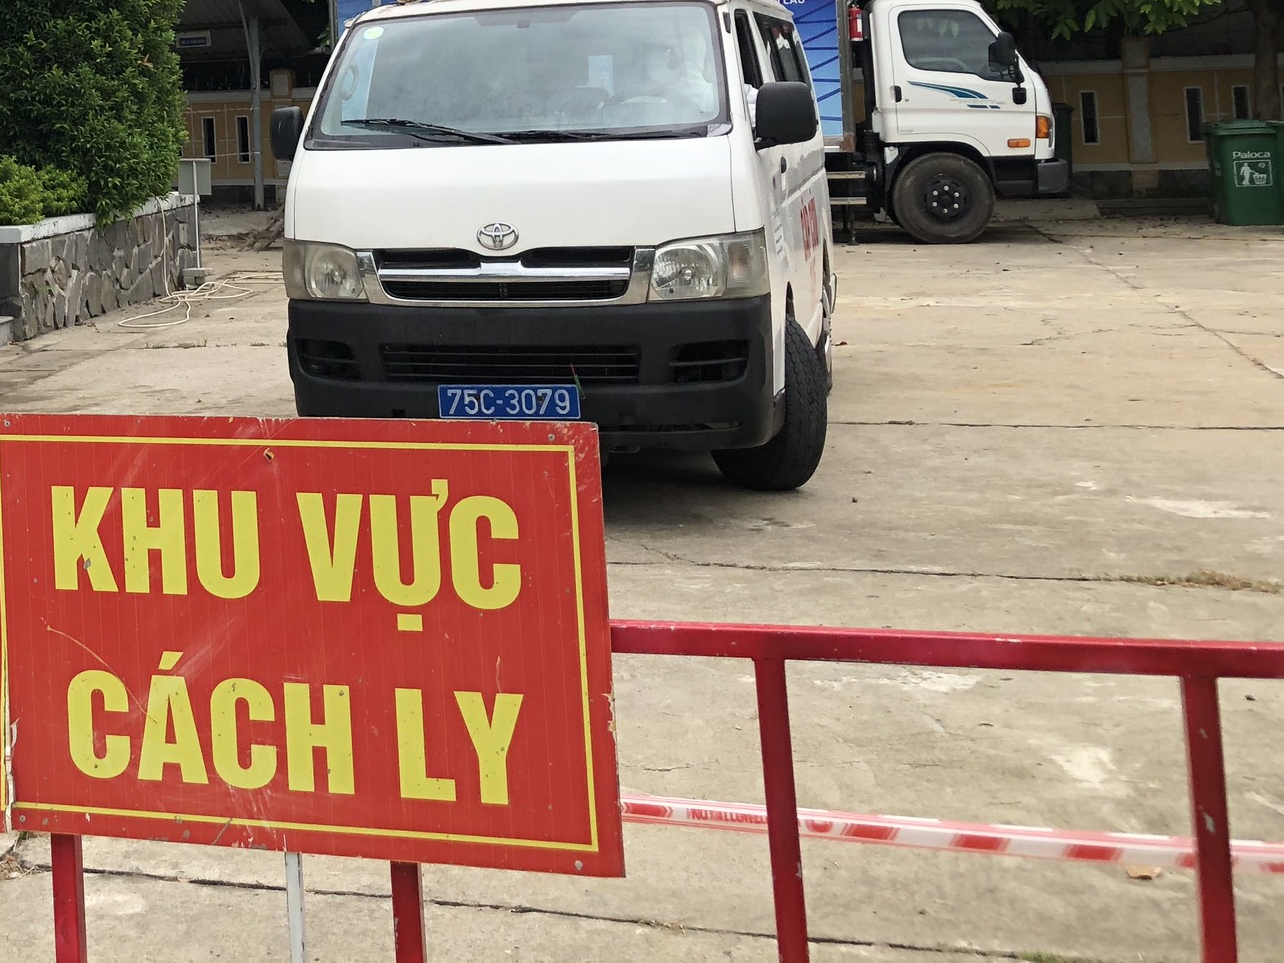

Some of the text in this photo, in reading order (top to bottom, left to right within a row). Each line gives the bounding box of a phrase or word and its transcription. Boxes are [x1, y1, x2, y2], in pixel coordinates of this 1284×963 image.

[1232, 150, 1271, 159] Paloca
[446, 388, 571, 415] 75C-3079
[51, 478, 522, 632] KHU VỰC
[66, 651, 525, 806] CÁCH LY
